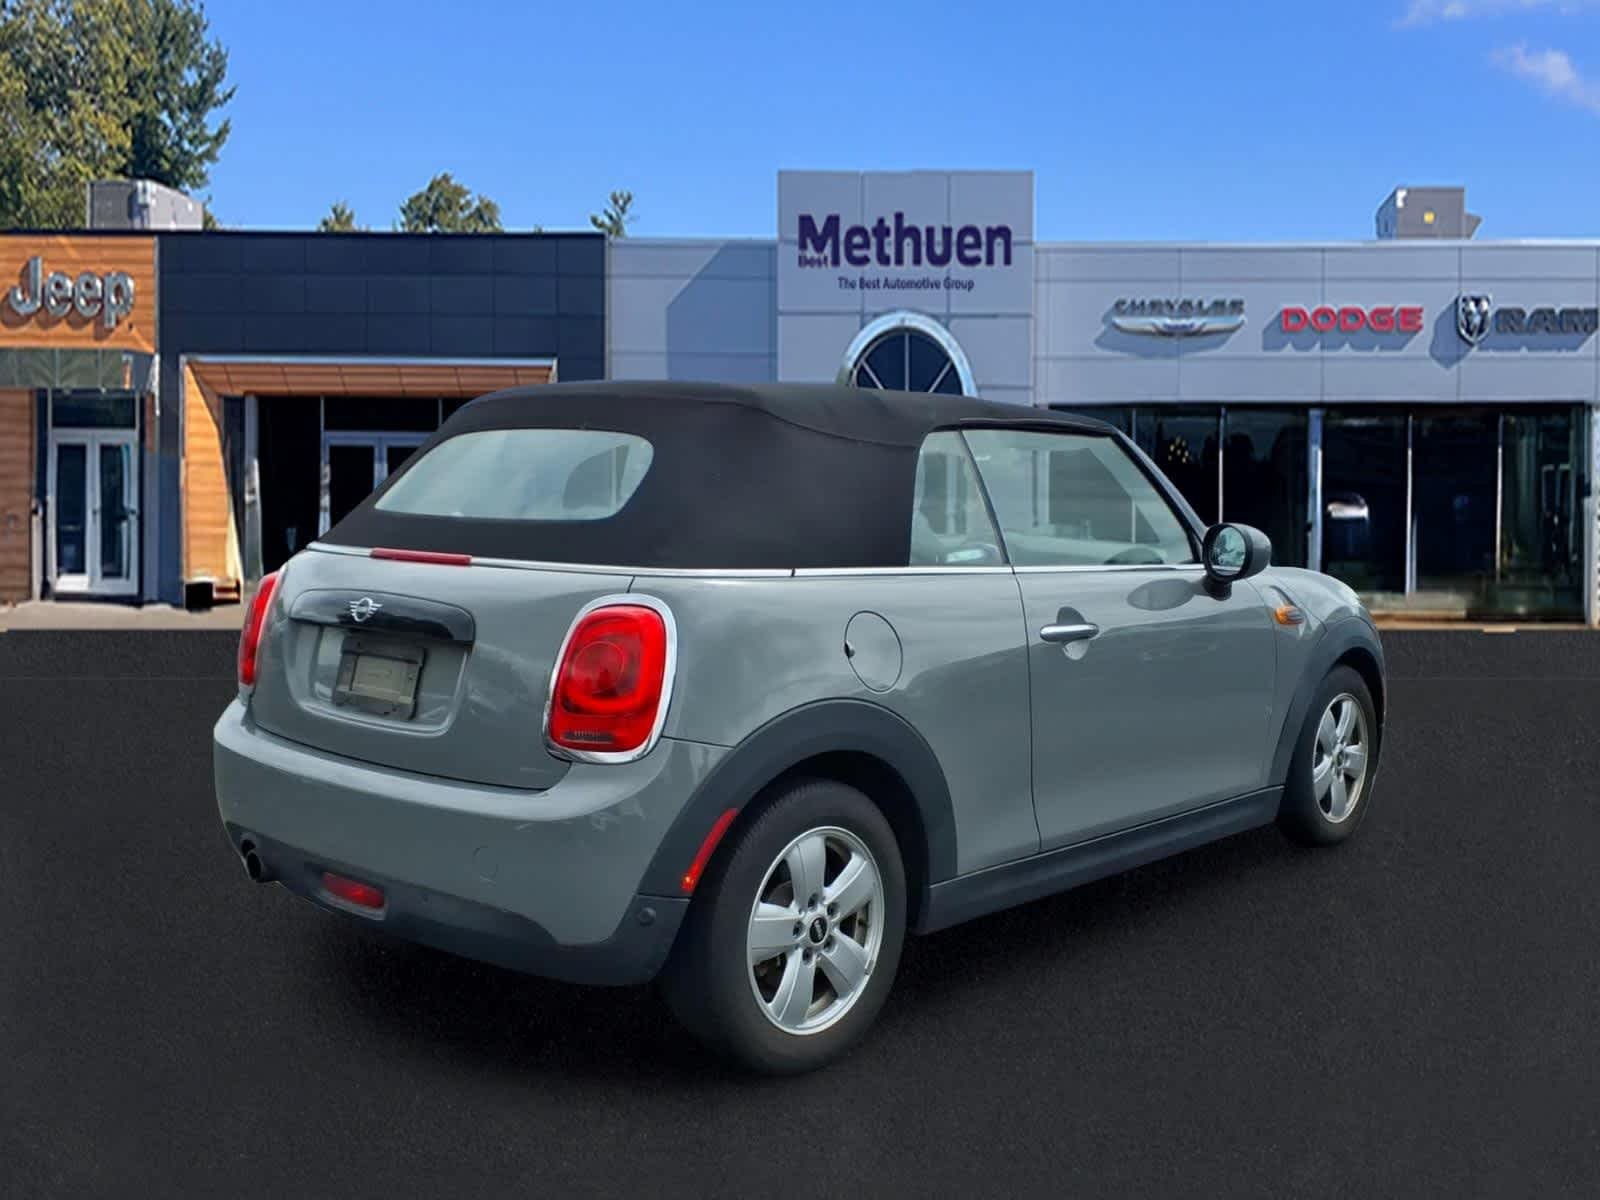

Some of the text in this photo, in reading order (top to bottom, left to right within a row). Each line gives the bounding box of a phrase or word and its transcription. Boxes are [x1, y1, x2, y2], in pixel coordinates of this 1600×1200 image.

[798, 212, 1012, 267] Methuen
[9, 256, 135, 328] Jeep
[838, 276, 975, 293] The Best Automotive Group
[1282, 306, 1424, 333] DODGE
[1495, 307, 1599, 334] RAM
